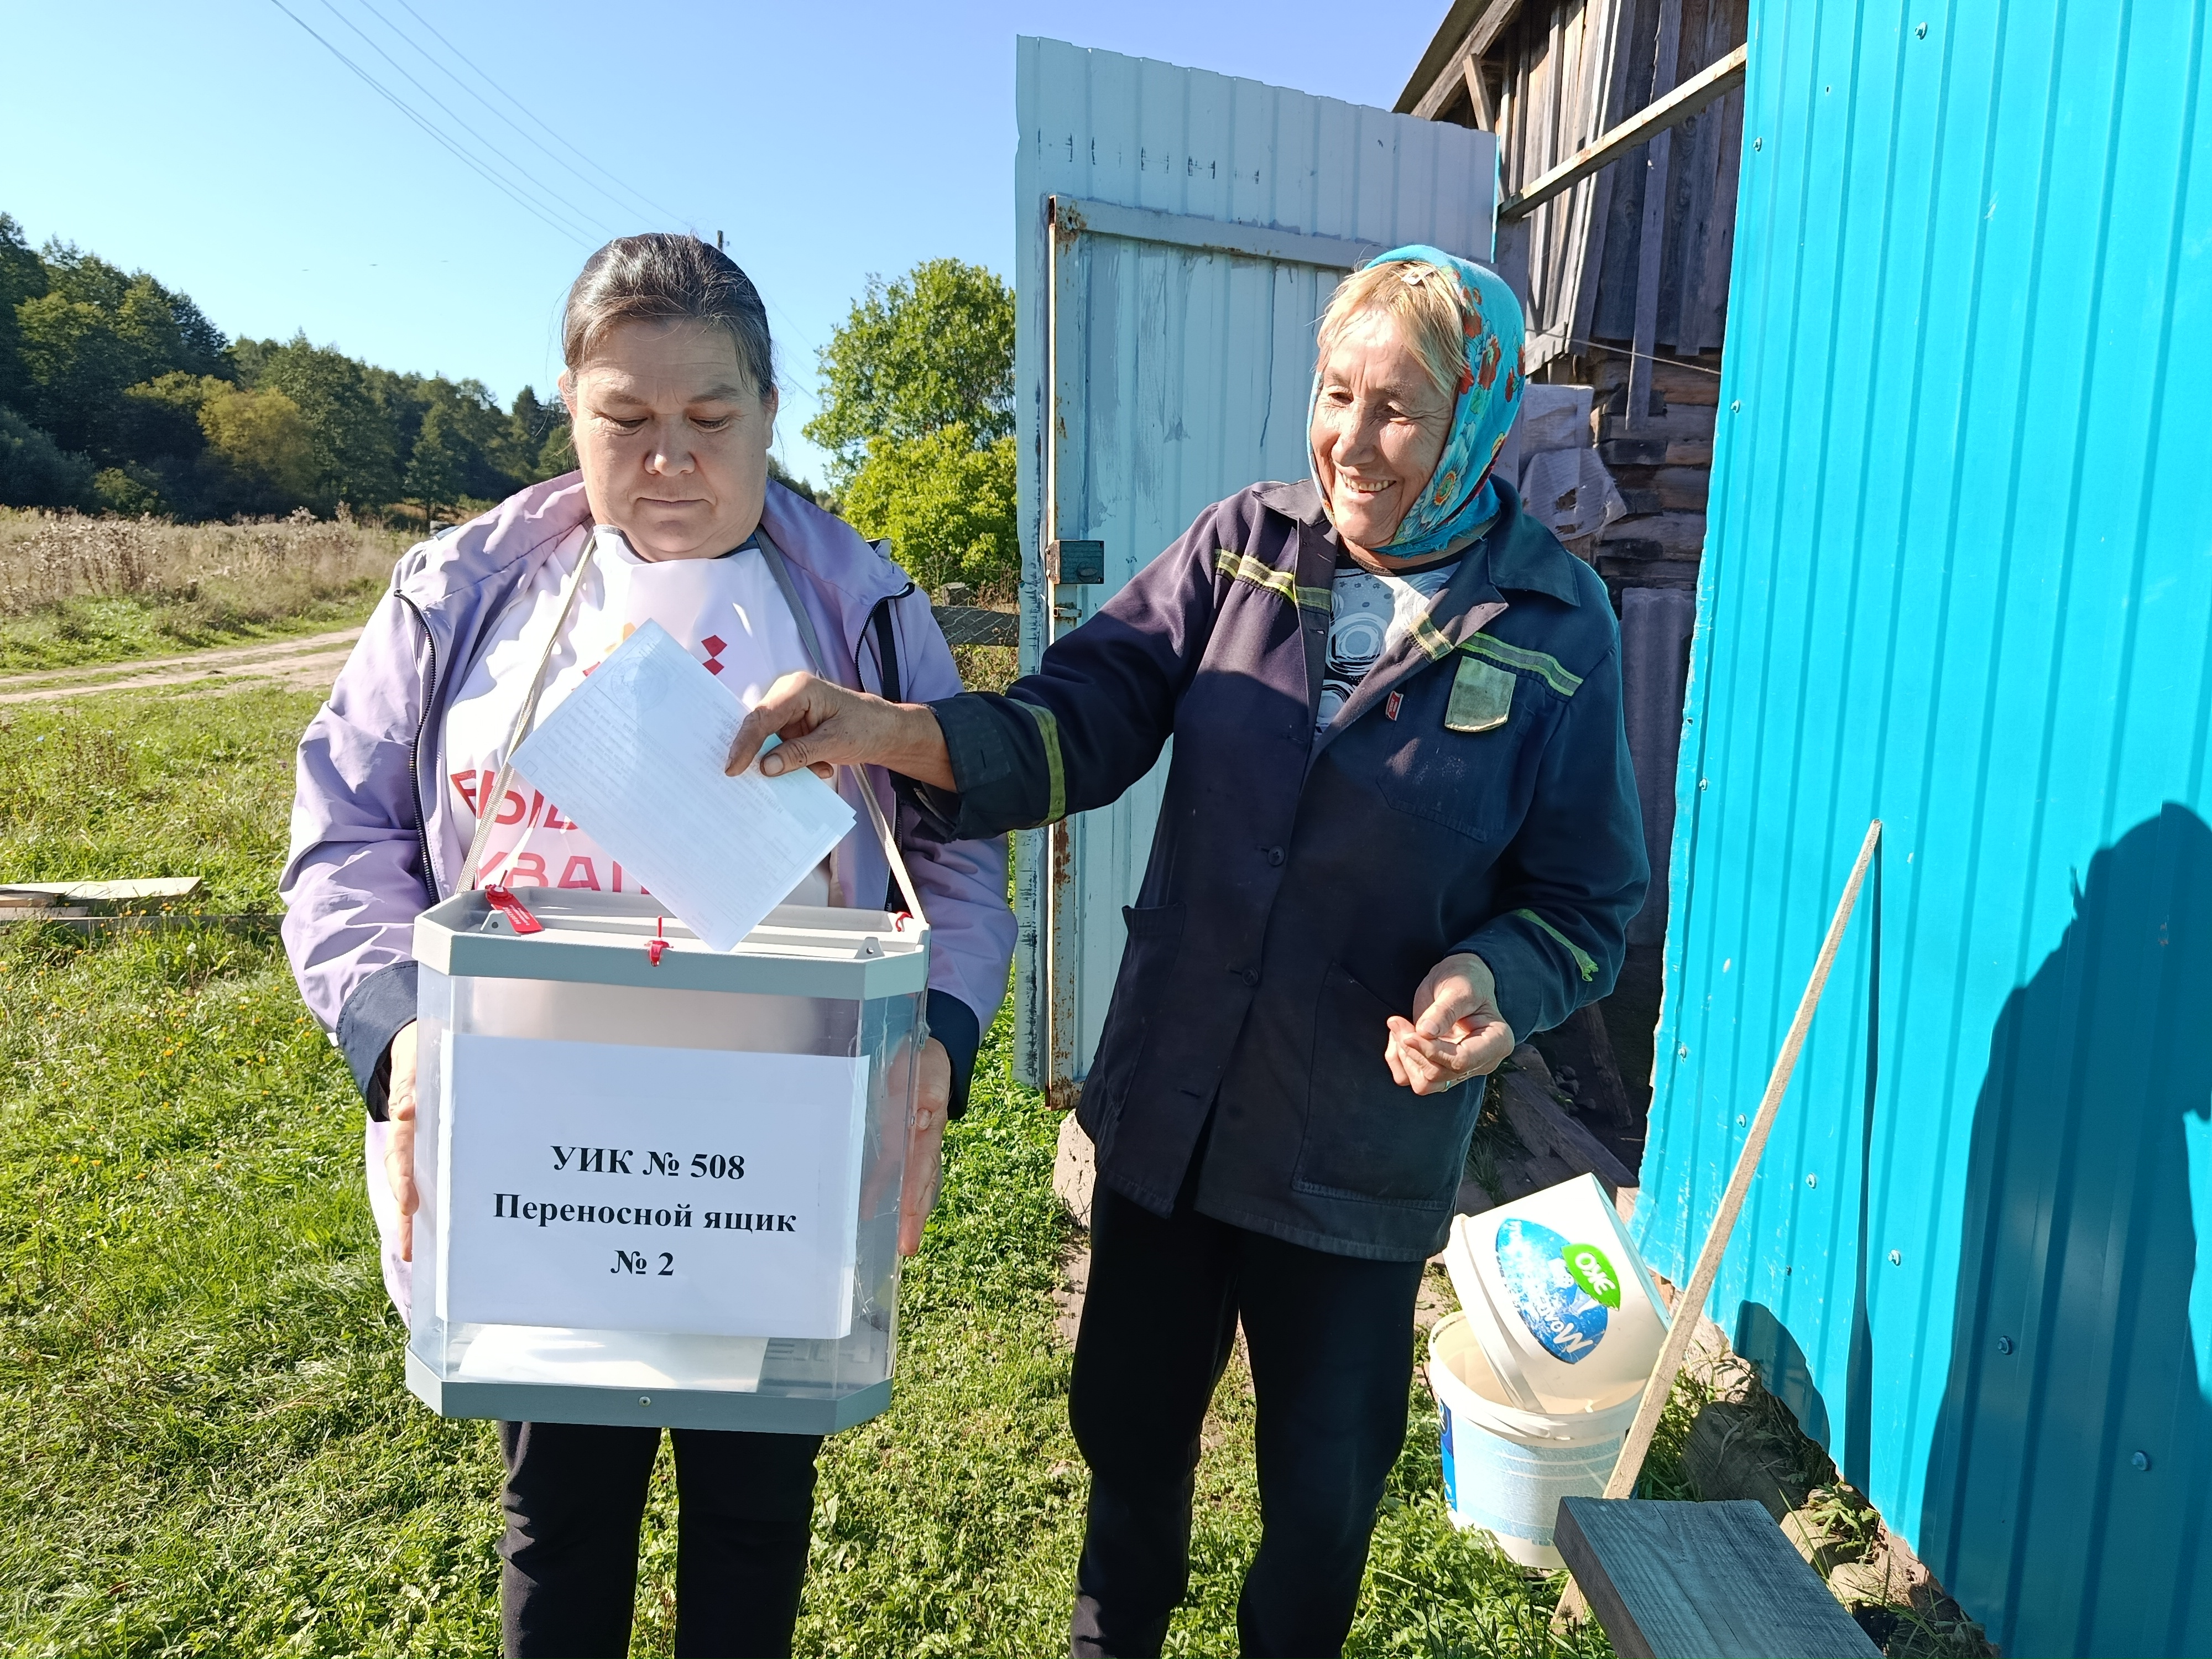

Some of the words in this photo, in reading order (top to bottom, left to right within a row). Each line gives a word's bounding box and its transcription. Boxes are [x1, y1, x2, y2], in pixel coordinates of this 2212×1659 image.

[551, 1145, 634, 1174] УИК
[642, 1151, 680, 1176] №
[690, 1154, 745, 1180] 508
[493, 1193, 693, 1227] Переносной
[703, 1212, 796, 1233] ящик
[610, 1250, 647, 1275] №
[658, 1252, 674, 1276] 2
[1575, 1253, 1616, 1296] ЭКО
